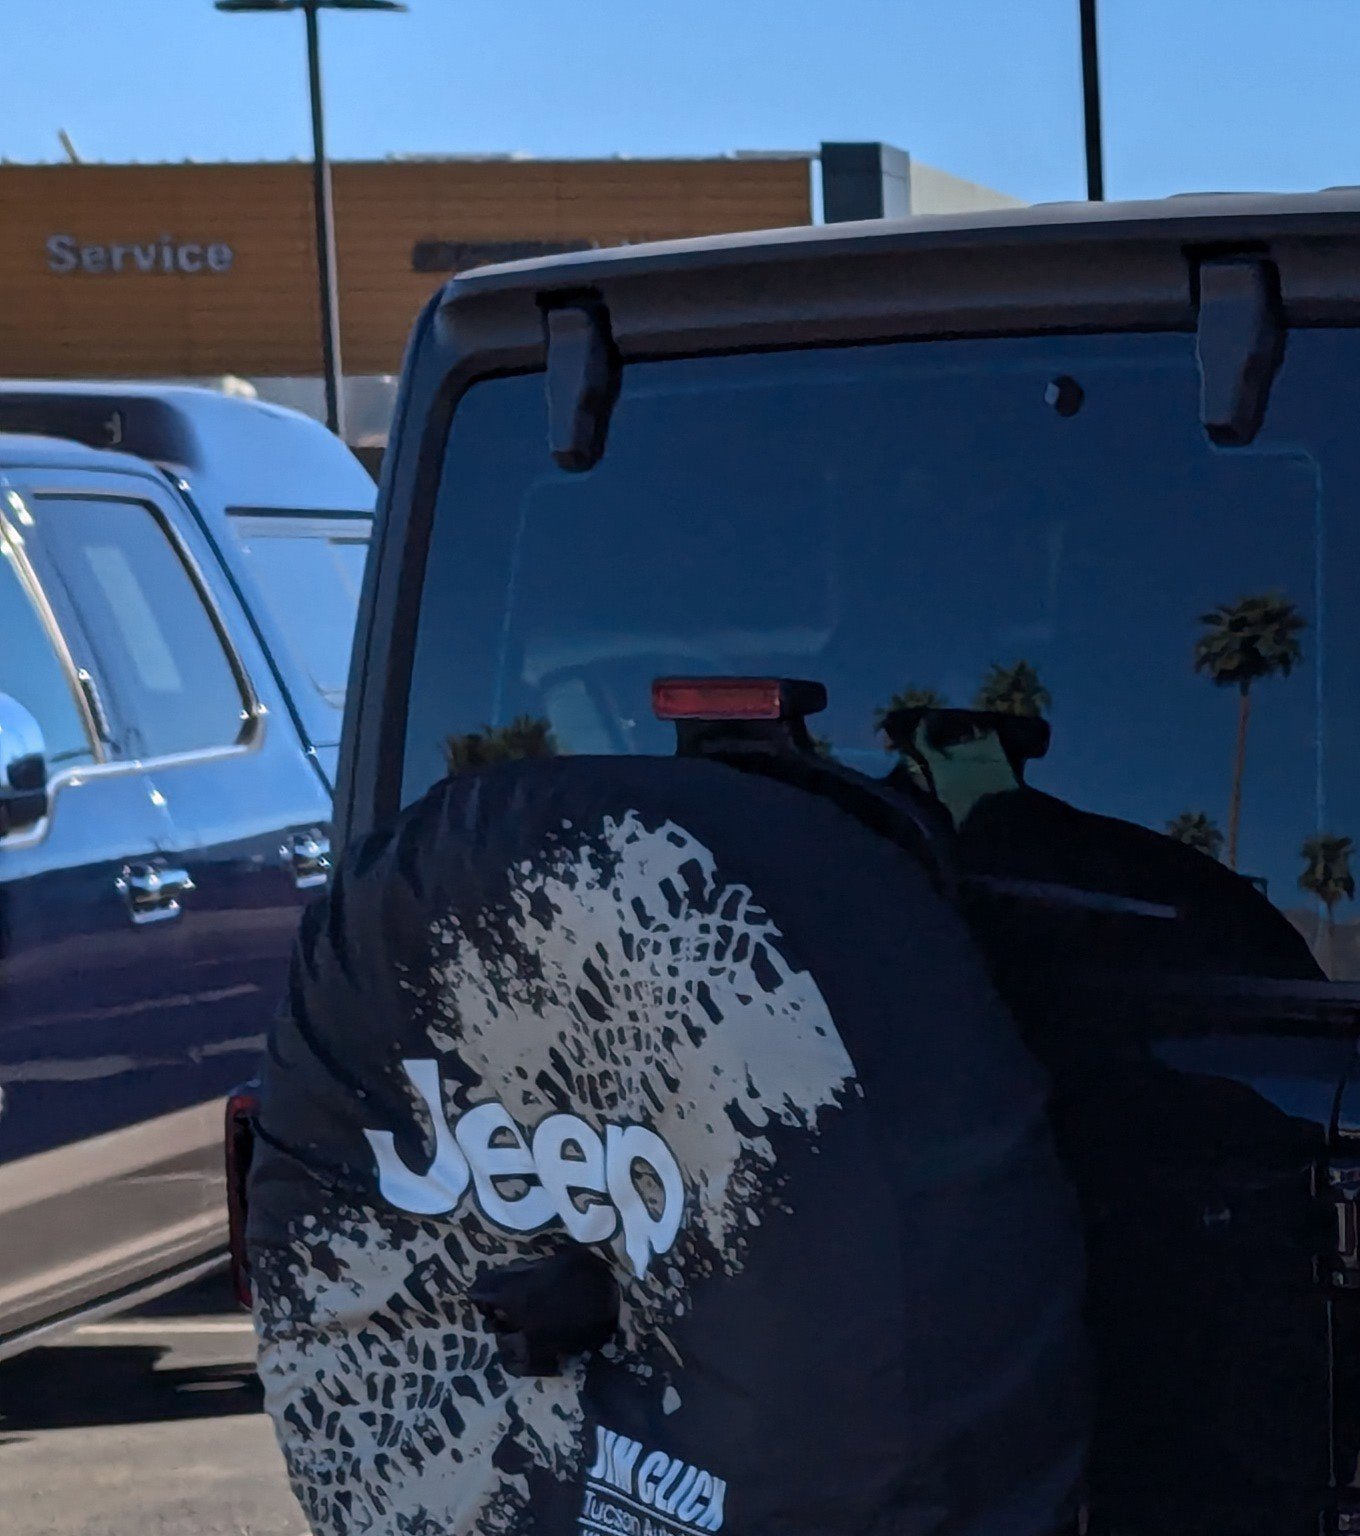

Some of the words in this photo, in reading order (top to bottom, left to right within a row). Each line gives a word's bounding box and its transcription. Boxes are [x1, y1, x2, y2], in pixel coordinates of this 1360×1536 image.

[46, 232, 233, 273] Service
[363, 1059, 685, 1281] Jeep
[582, 1490, 640, 1536] Tucson
[587, 1425, 643, 1495] JIM
[637, 1450, 727, 1532] CLICK
